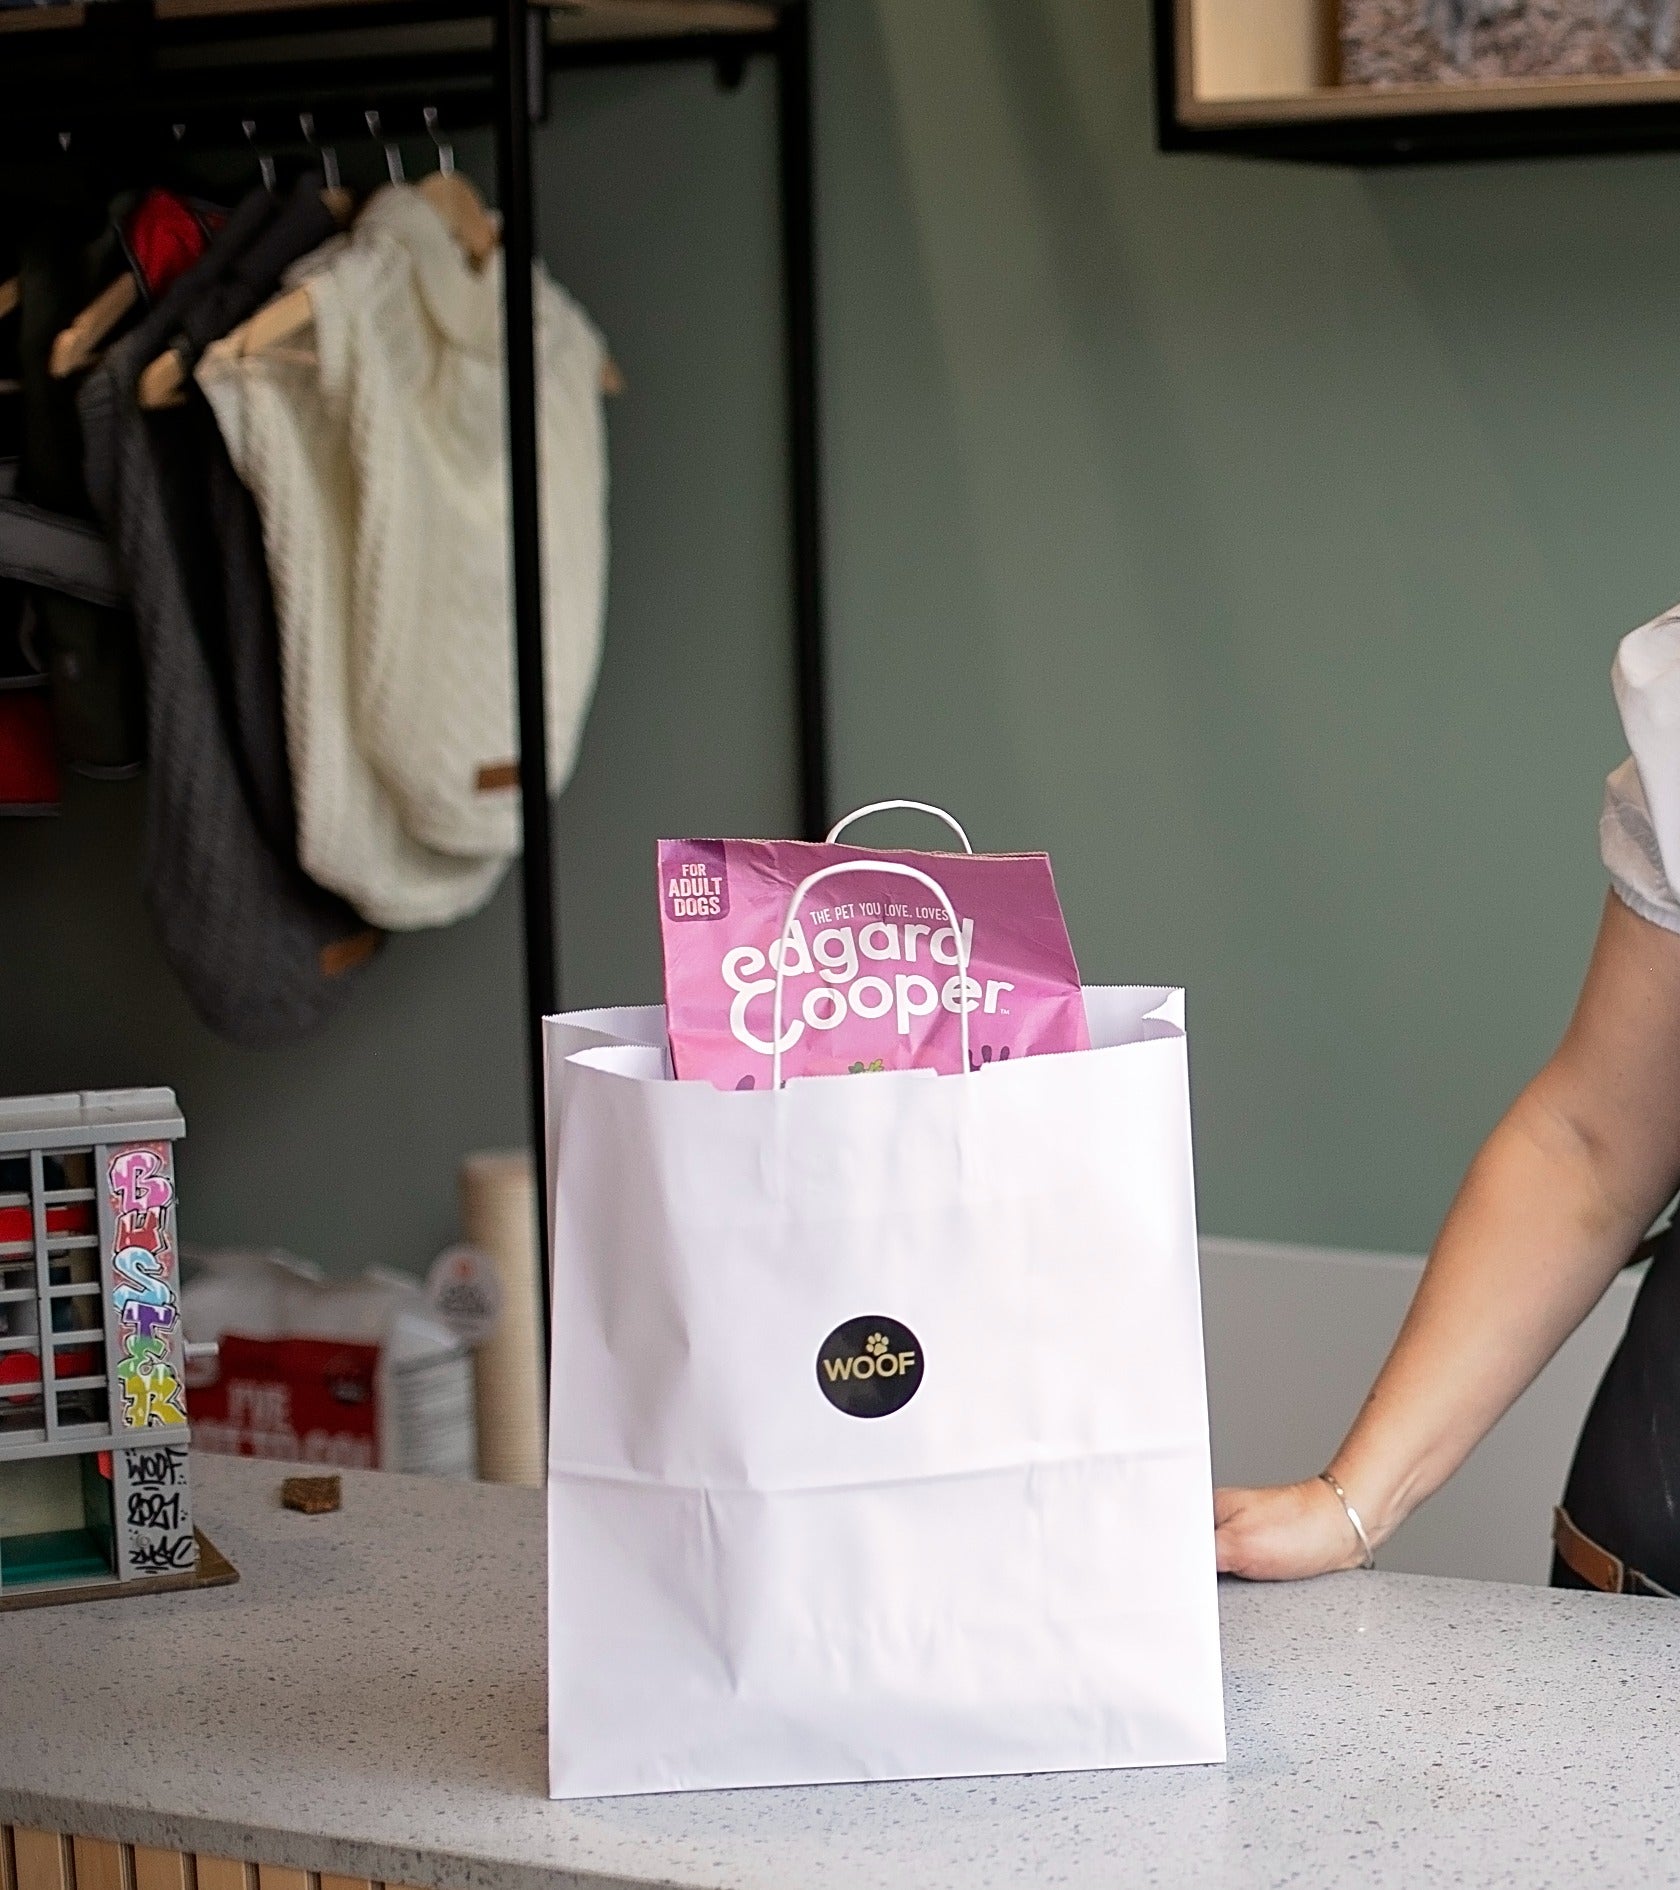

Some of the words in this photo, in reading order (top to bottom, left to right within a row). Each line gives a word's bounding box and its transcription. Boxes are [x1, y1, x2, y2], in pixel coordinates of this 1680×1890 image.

[681, 863, 707, 877] FOR
[668, 877, 723, 898] ADULT
[673, 896, 721, 917] DOGS
[809, 908, 833, 926] THE
[834, 903, 855, 921] PET
[858, 902, 881, 917] YOU
[915, 907, 950, 921] LOVES
[730, 974, 1015, 1055] Cooper
[107, 1150, 188, 1428] BUSTER
[823, 1350, 916, 1382] WOOF
[126, 1446, 189, 1486] WOOF
[127, 1491, 181, 1531] 2021
